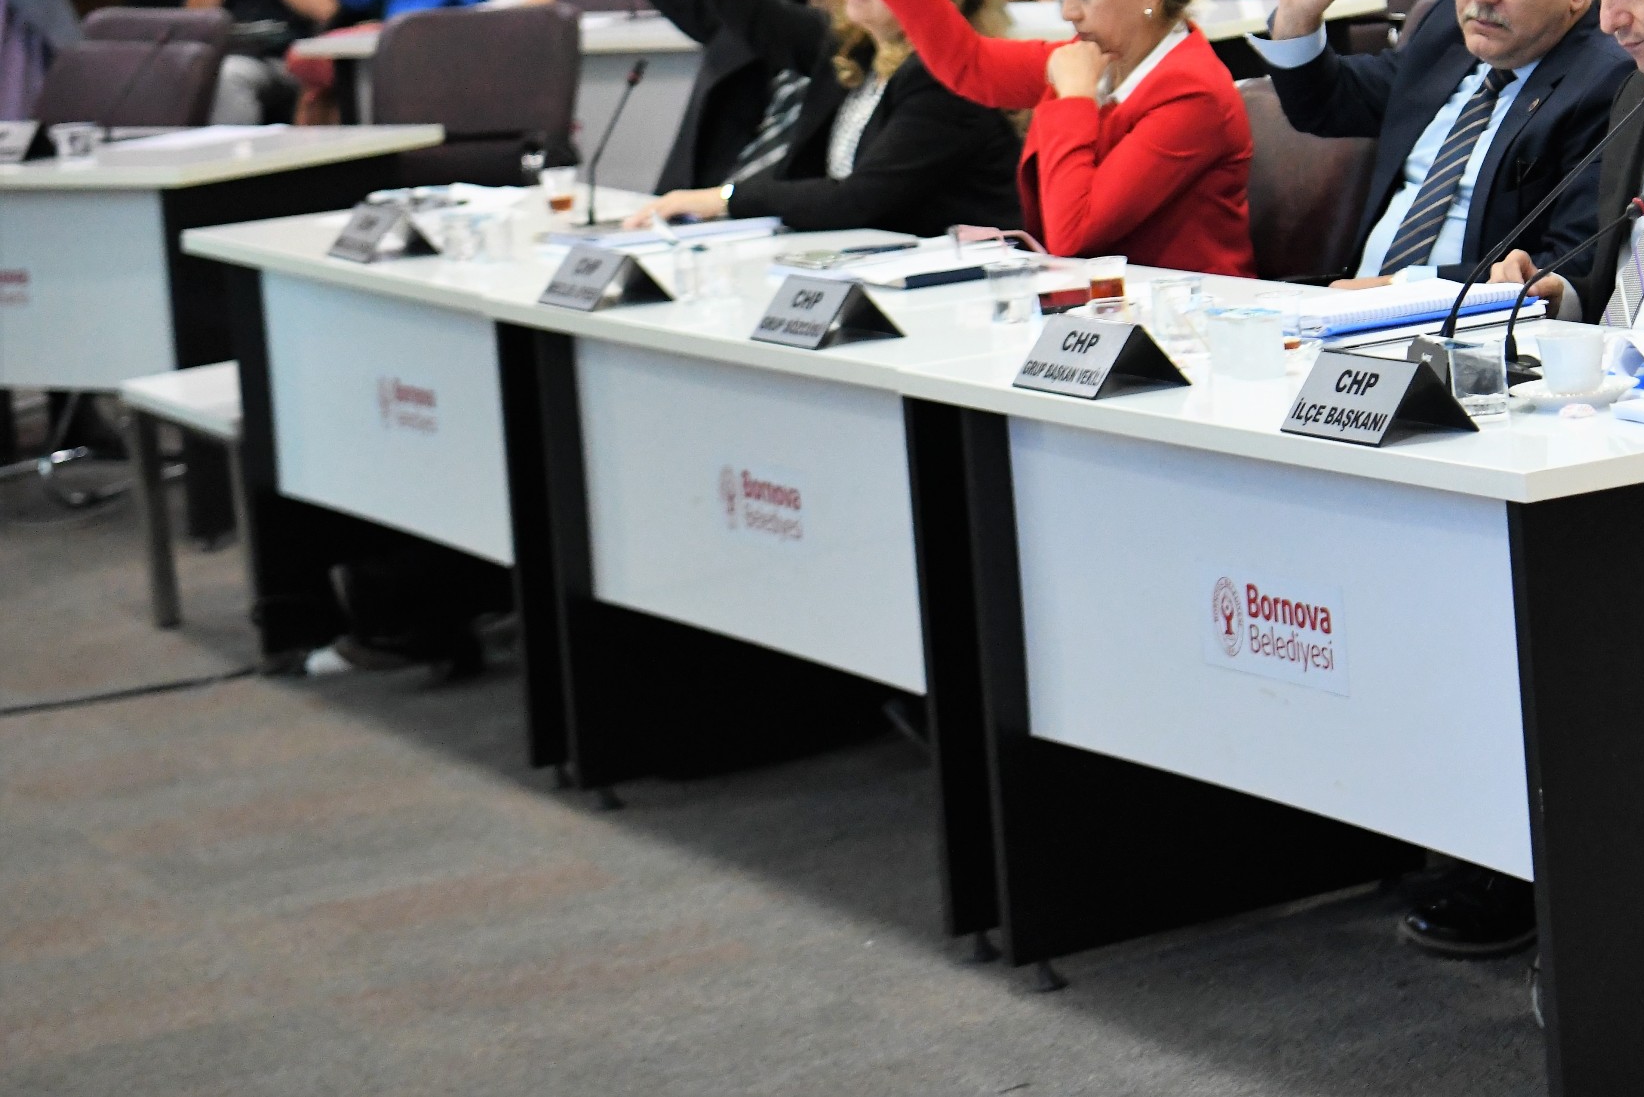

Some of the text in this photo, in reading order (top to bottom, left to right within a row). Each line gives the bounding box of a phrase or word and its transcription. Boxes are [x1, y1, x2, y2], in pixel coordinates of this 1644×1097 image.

[791, 288, 824, 310] CHP
[1062, 329, 1101, 354] CHP
[1022, 360, 1048, 377] GRUP
[1042, 363, 1080, 384] BAŞKAN
[1335, 368, 1380, 396] CHP
[1291, 398, 1389, 433] İLÇE BAŞKANI
[741, 469, 802, 511] Bornova
[1245, 583, 1333, 635] Bornova
[1249, 624, 1334, 673] Belediyesi
